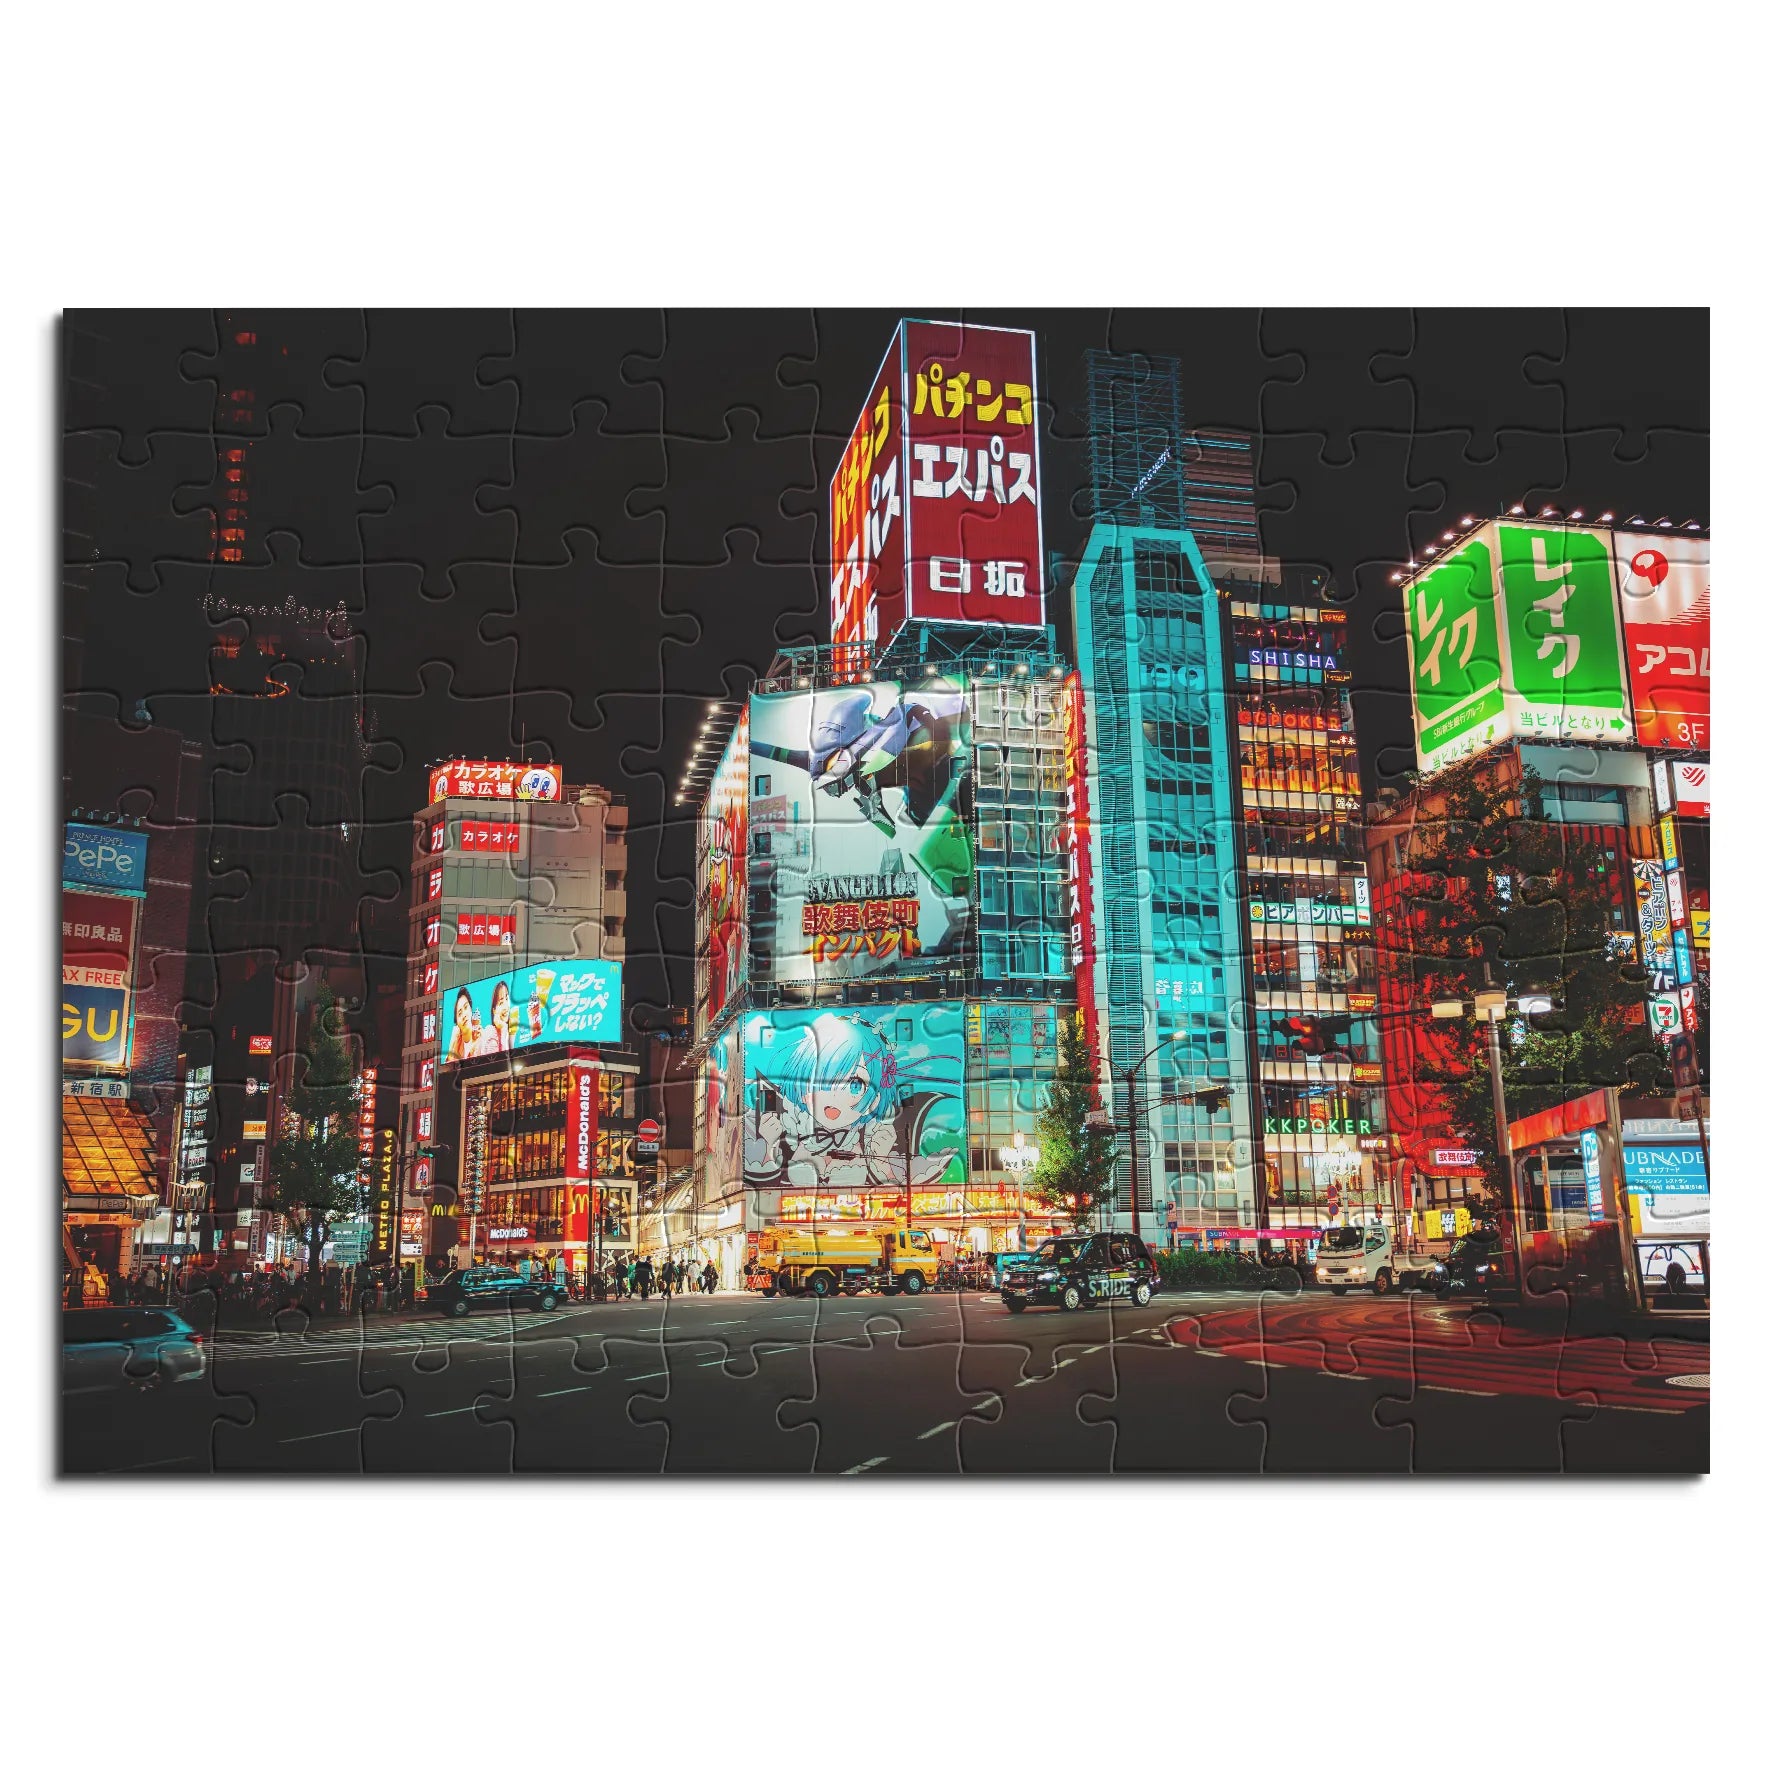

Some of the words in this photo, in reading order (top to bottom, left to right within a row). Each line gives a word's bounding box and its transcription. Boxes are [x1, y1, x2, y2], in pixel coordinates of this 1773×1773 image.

[912, 363, 1033, 425] パチンコ
[834, 385, 890, 545] パチンコ
[912, 435, 1037, 505] エスパス
[831, 455, 901, 632] エスパス
[929, 555, 1026, 598] 日拓
[1531, 537, 1581, 679] レイク
[1416, 590, 1478, 687] レイク
[1251, 650, 1336, 669] SHISHA
[1520, 713, 1606, 729] 当ビルとなり
[1677, 722, 1705, 742] 3F
[454, 763, 523, 781] カラオケ
[458, 780, 513, 796] 歌広場
[463, 830, 519, 844] カラオケ
[1357, 880, 1367, 904] ダーツ
[803, 899, 920, 935] 歌舞伎町
[1266, 905, 1354, 922] ビアボンバー
[63, 922, 123, 943] 無印良品
[458, 924, 501, 937] 歌広場
[802, 928, 922, 963] インパクト
[85, 970, 122, 986] FREE
[560, 972, 606, 993] マックで
[1652, 970, 1675, 990] 7F
[550, 991, 609, 1017] フラッペ
[63, 1081, 122, 1097] 新宿駅
[578, 1074, 590, 1171] McDonald's
[1265, 1118, 1372, 1134] KKPOKER
[490, 1228, 528, 1239] McDonald's
[1088, 1279, 1131, 1298] S.RIDE
